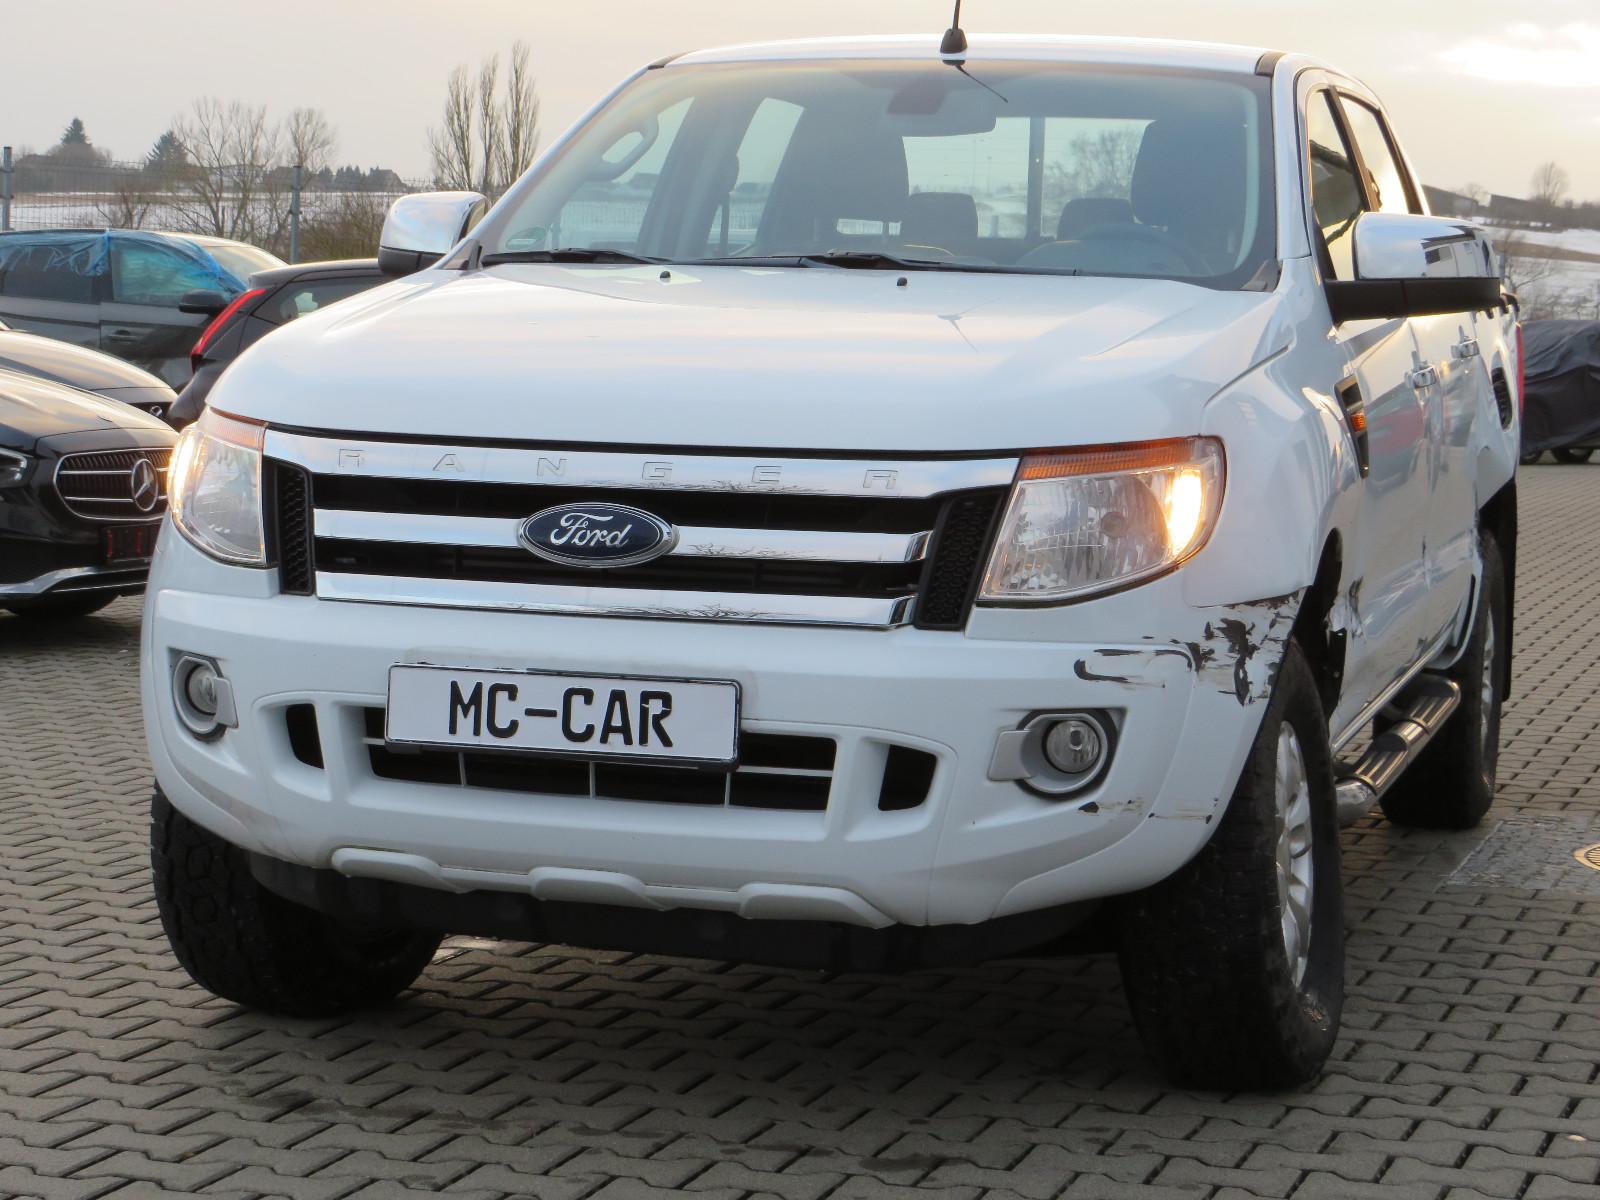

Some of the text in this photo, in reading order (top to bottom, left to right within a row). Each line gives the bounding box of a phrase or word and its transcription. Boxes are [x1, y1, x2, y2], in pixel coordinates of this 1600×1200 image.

[337, 448, 899, 490] RANGER
[550, 512, 633, 548] Ford
[448, 680, 674, 748] MC-CAR
